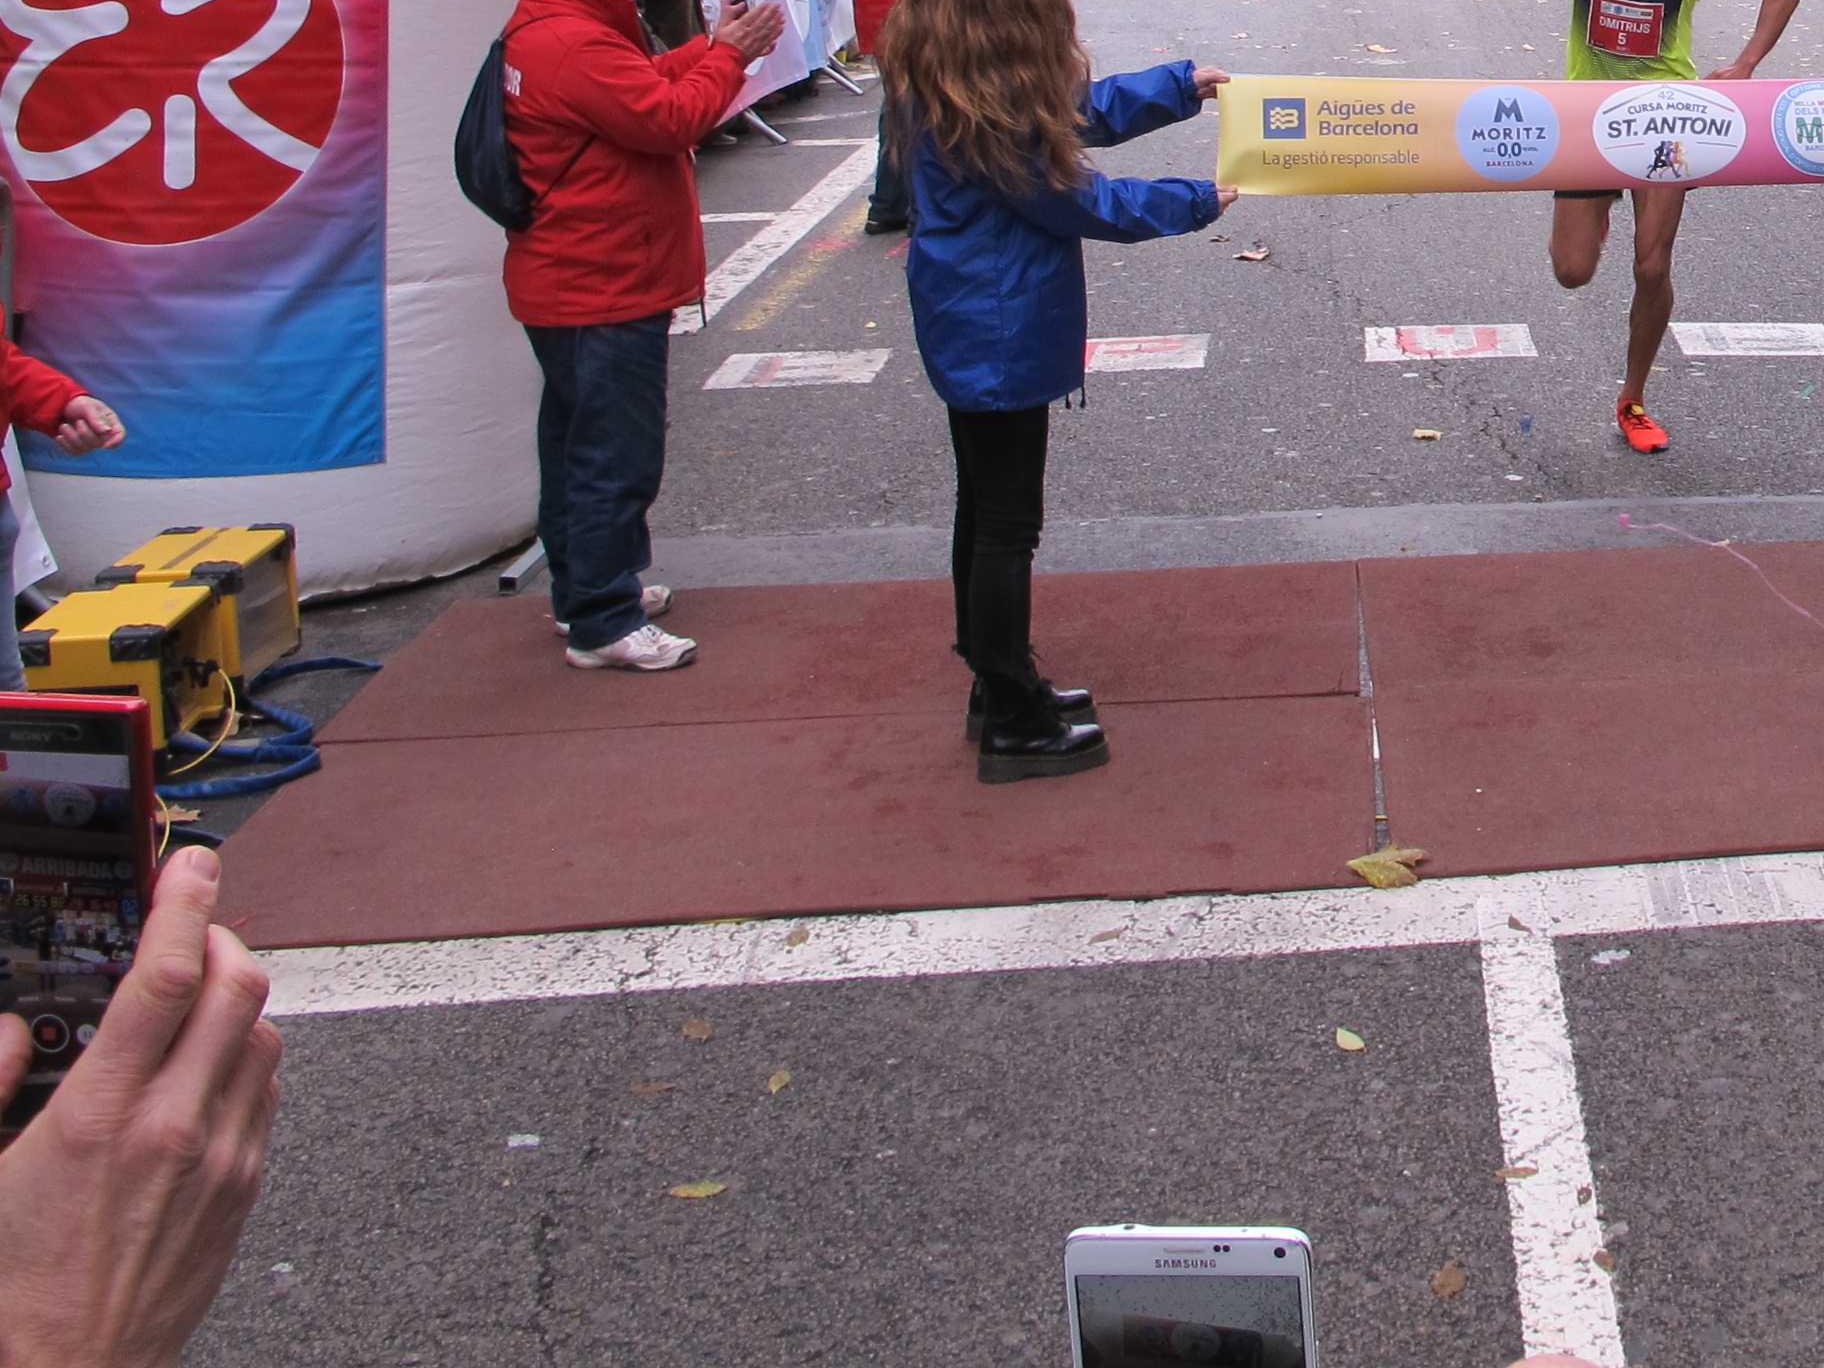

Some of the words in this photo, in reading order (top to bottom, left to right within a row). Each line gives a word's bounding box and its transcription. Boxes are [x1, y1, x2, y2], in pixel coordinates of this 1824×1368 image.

[1599, 15, 1651, 34] DMITRIJS
[1617, 33, 1627, 46] 5
[1657, 90, 1675, 100] 42
[1316, 100, 1385, 120] Aigües
[1391, 100, 1415, 115] de
[1627, 102, 1664, 115] CURSA
[1666, 102, 1708, 115] MORITZ
[1318, 120, 1419, 136] Barcelona
[1471, 127, 1547, 141] MORITZ
[1607, 119, 1639, 139] ST.
[1643, 117, 1733, 137] ANTONI
[1497, 142, 1523, 159] 0,0
[1263, 150, 1280, 166] La
[1283, 150, 1329, 170] gestió
[1332, 150, 1420, 168] responsable
[21, 856, 114, 879] ARRIBADA
[1155, 1258, 1217, 1269] SAMSUNG
